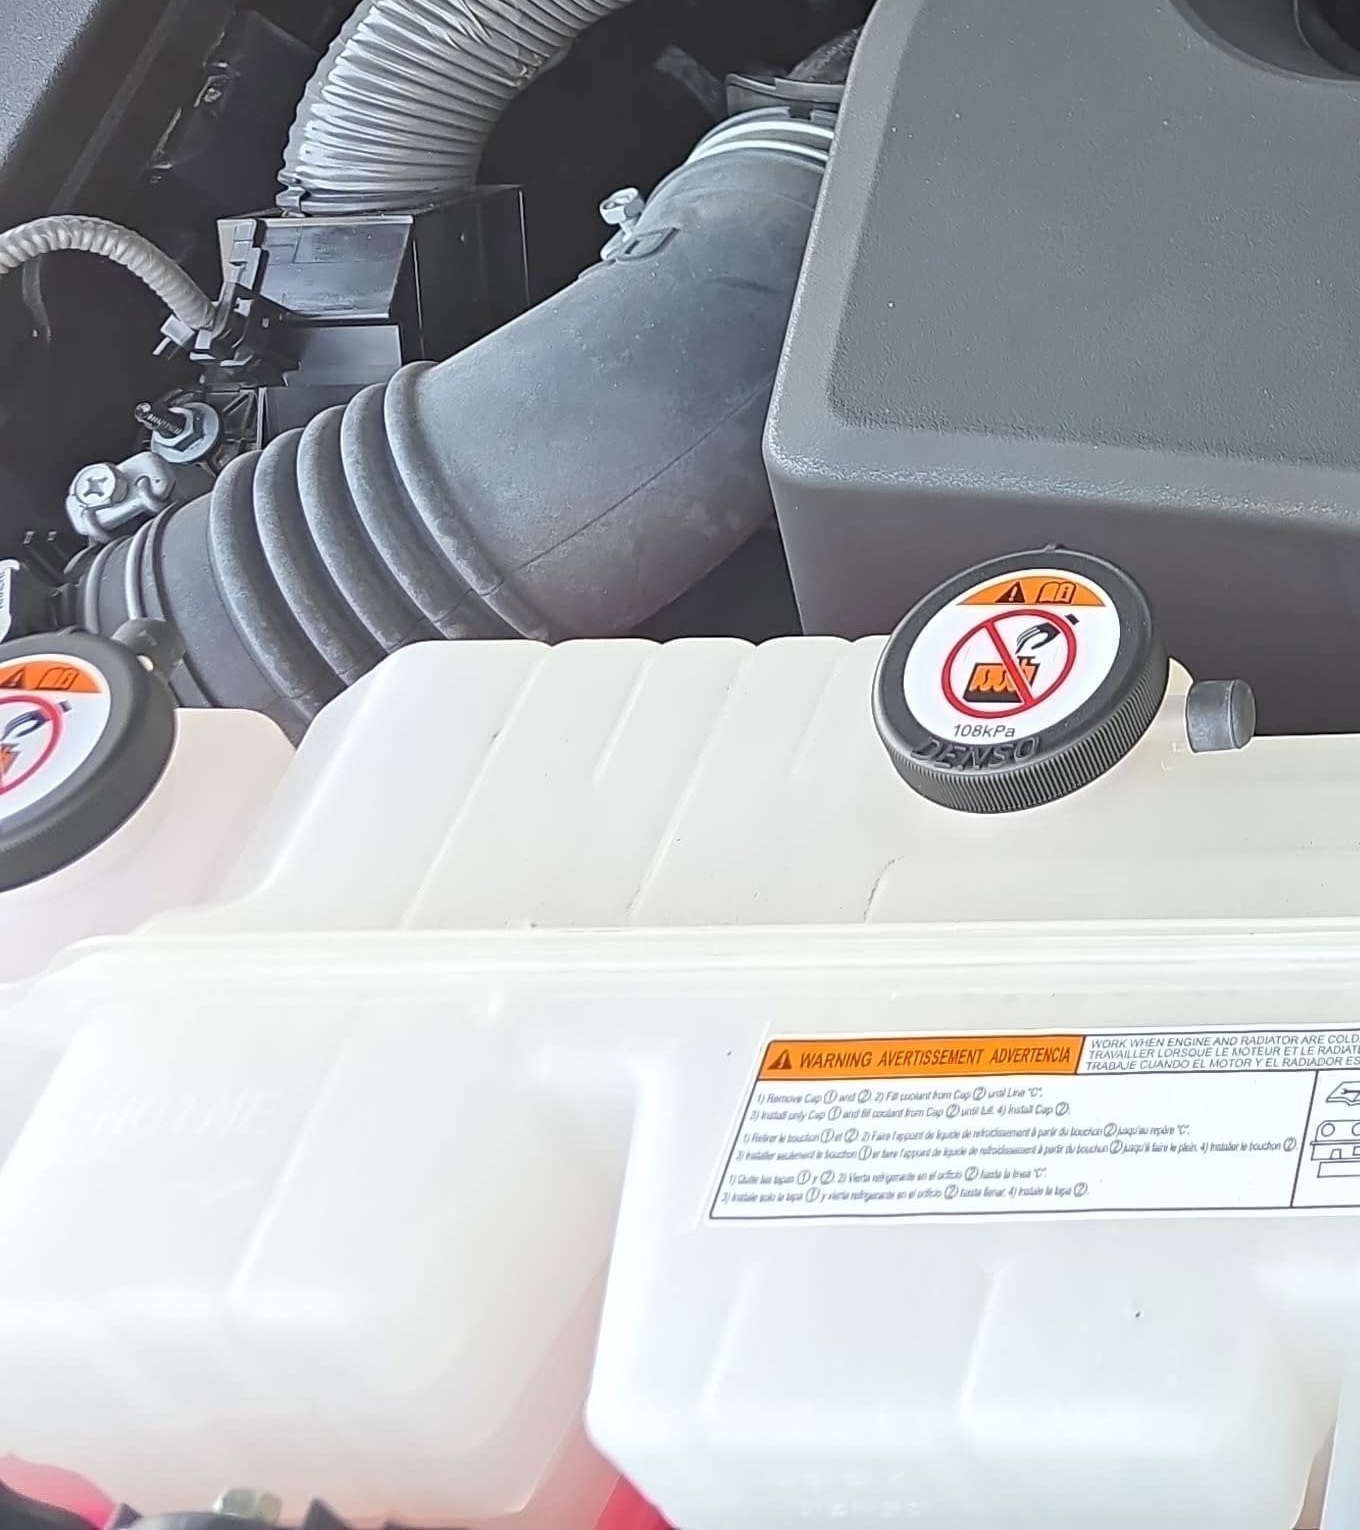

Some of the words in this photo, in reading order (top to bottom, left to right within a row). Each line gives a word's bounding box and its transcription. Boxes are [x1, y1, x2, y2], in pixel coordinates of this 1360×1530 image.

[952, 723, 1015, 739] 108kPa
[911, 736, 1041, 771] DENSO
[1090, 1038, 1126, 1048] WORK
[1129, 1038, 1165, 1047] WHEN
[1166, 1037, 1213, 1047] ENGINE
[1212, 1036, 1238, 1046] AND
[1239, 1035, 1299, 1045] RADIATOR
[1300, 1035, 1327, 1044] ARE
[798, 1051, 873, 1068] WARNING
[877, 1049, 982, 1066] AVERTISSEMENT
[989, 1047, 1072, 1063] ADVERTENCIA
[1087, 1049, 1155, 1059] TRAVAILLER
[1156, 1048, 1213, 1057] LORSQUE
[1214, 1047, 1230, 1057] LE
[1230, 1047, 1282, 1056] MOTEUR
[1283, 1046, 1298, 1055] ET
[1299, 1046, 1315, 1055] LE
[1084, 1060, 1137, 1070] TRABAJE
[1138, 1059, 1190, 1069] CUANDO
[1191, 1059, 1207, 1068] EL
[1208, 1058, 1252, 1068] MOTOR
[1253, 1058, 1263, 1067] Y
[1264, 1058, 1280, 1067] EL
[1281, 1057, 1343, 1067] RADIADOR
